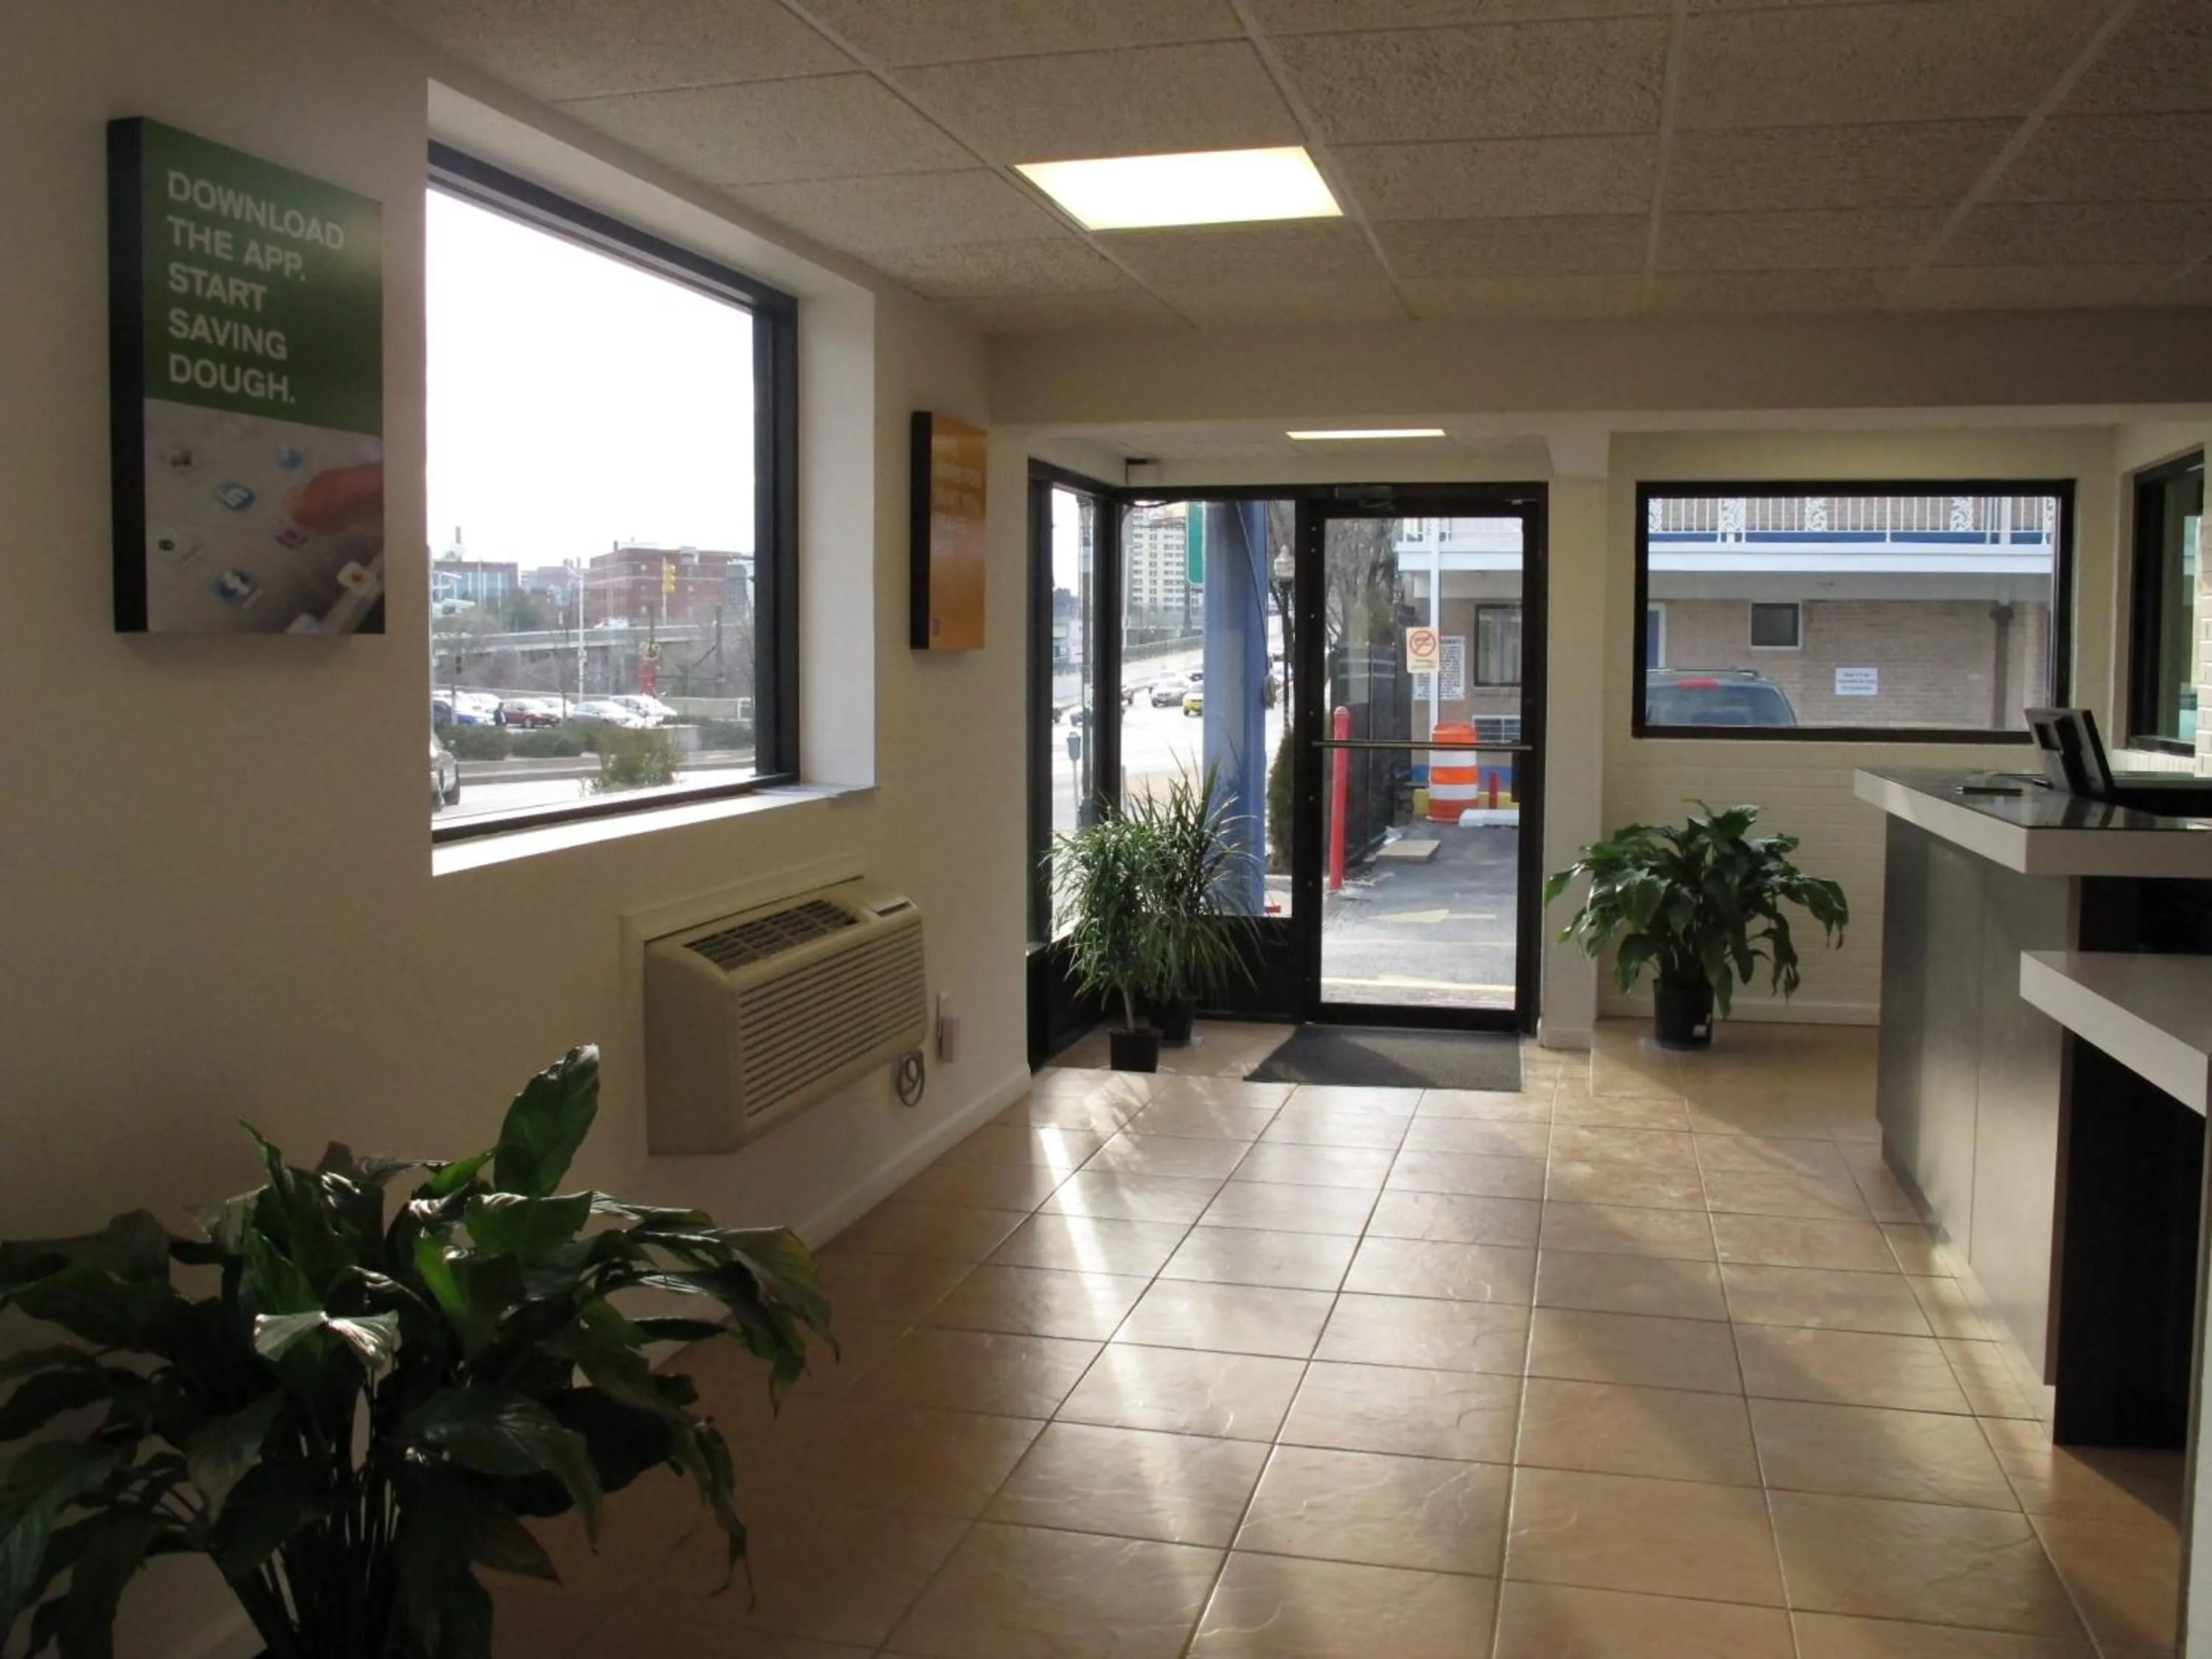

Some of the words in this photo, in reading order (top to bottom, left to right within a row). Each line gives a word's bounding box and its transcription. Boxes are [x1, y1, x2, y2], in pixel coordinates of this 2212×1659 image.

[167, 170, 344, 250] DOWNLOAD
[167, 215, 234, 261] THE
[243, 240, 306, 282] APP.
[168, 263, 267, 312] START
[168, 307, 287, 361] SAVING
[169, 354, 296, 405] DOUGH.
